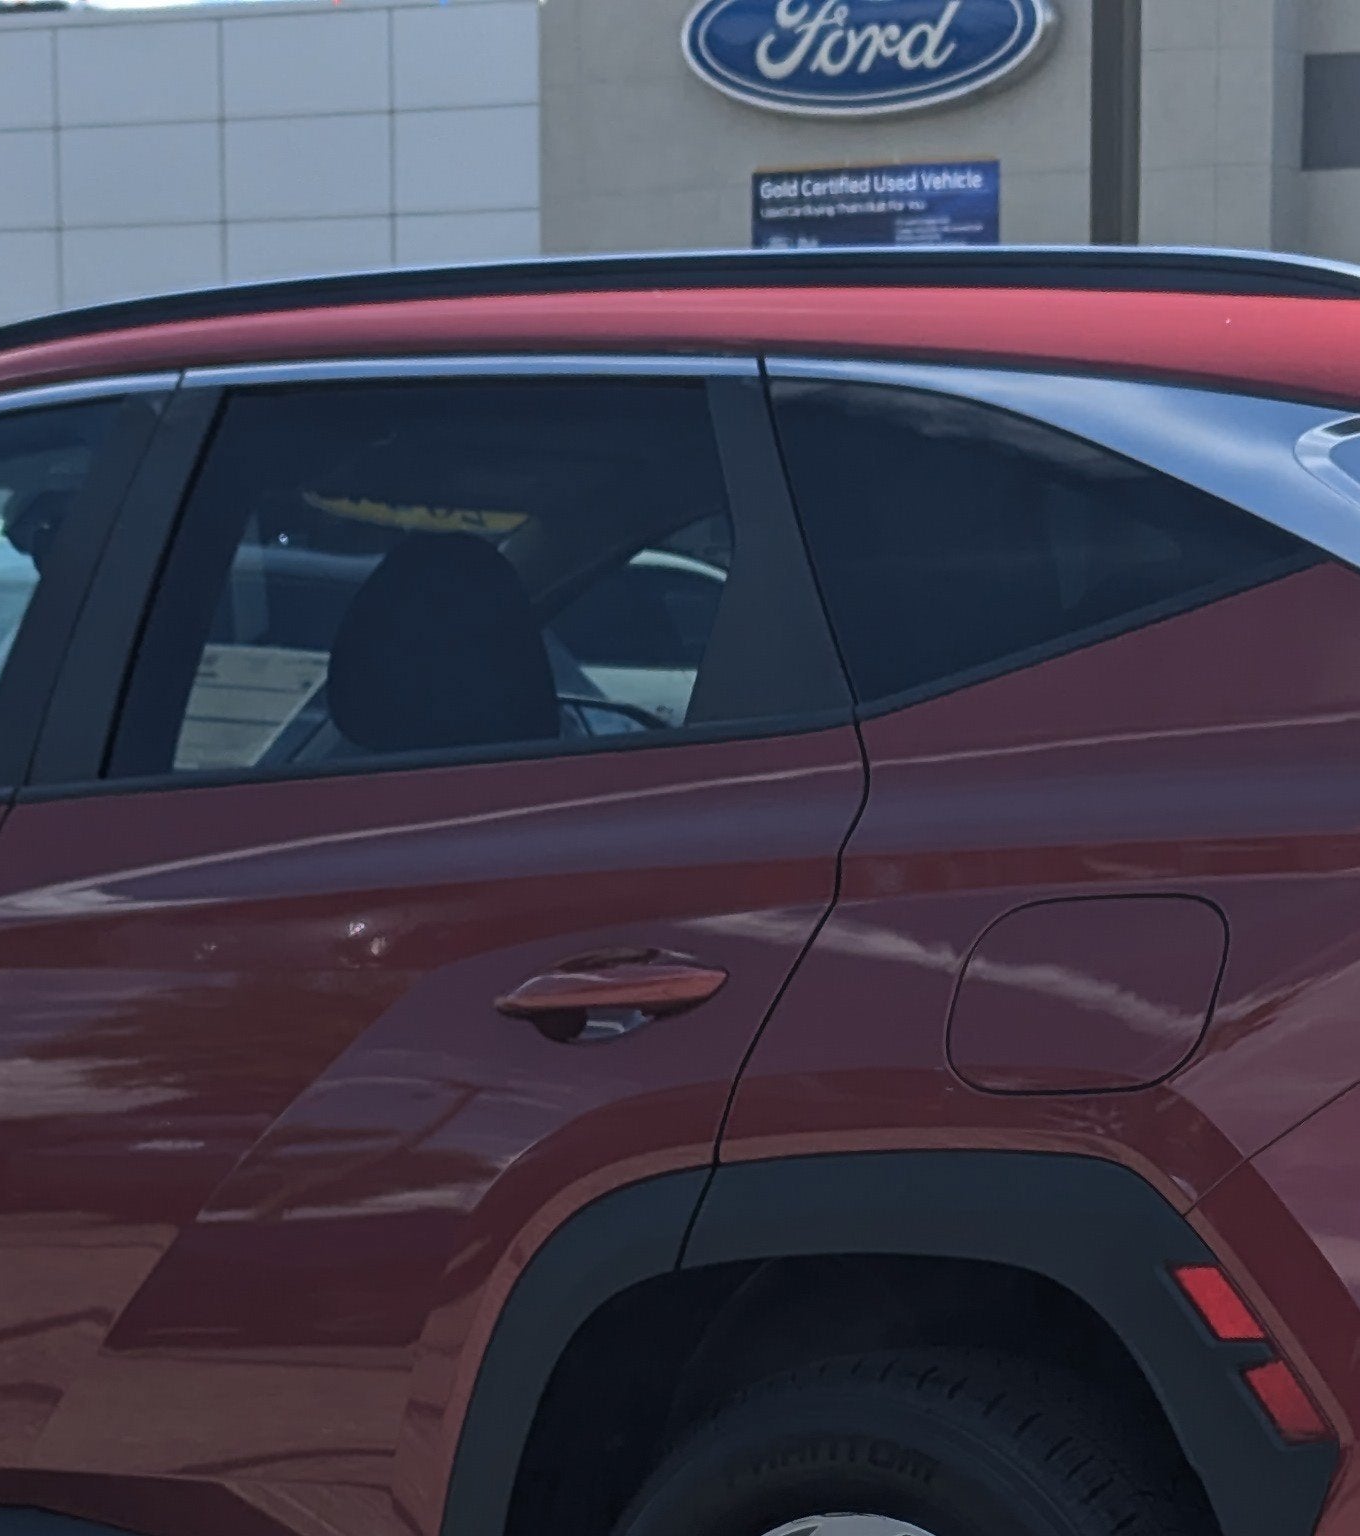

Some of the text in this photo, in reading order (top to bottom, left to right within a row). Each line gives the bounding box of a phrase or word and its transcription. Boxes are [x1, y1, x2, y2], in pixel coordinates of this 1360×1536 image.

[755, 0, 962, 80] Ford
[760, 171, 983, 199] Gold Certified Used Vehicle
